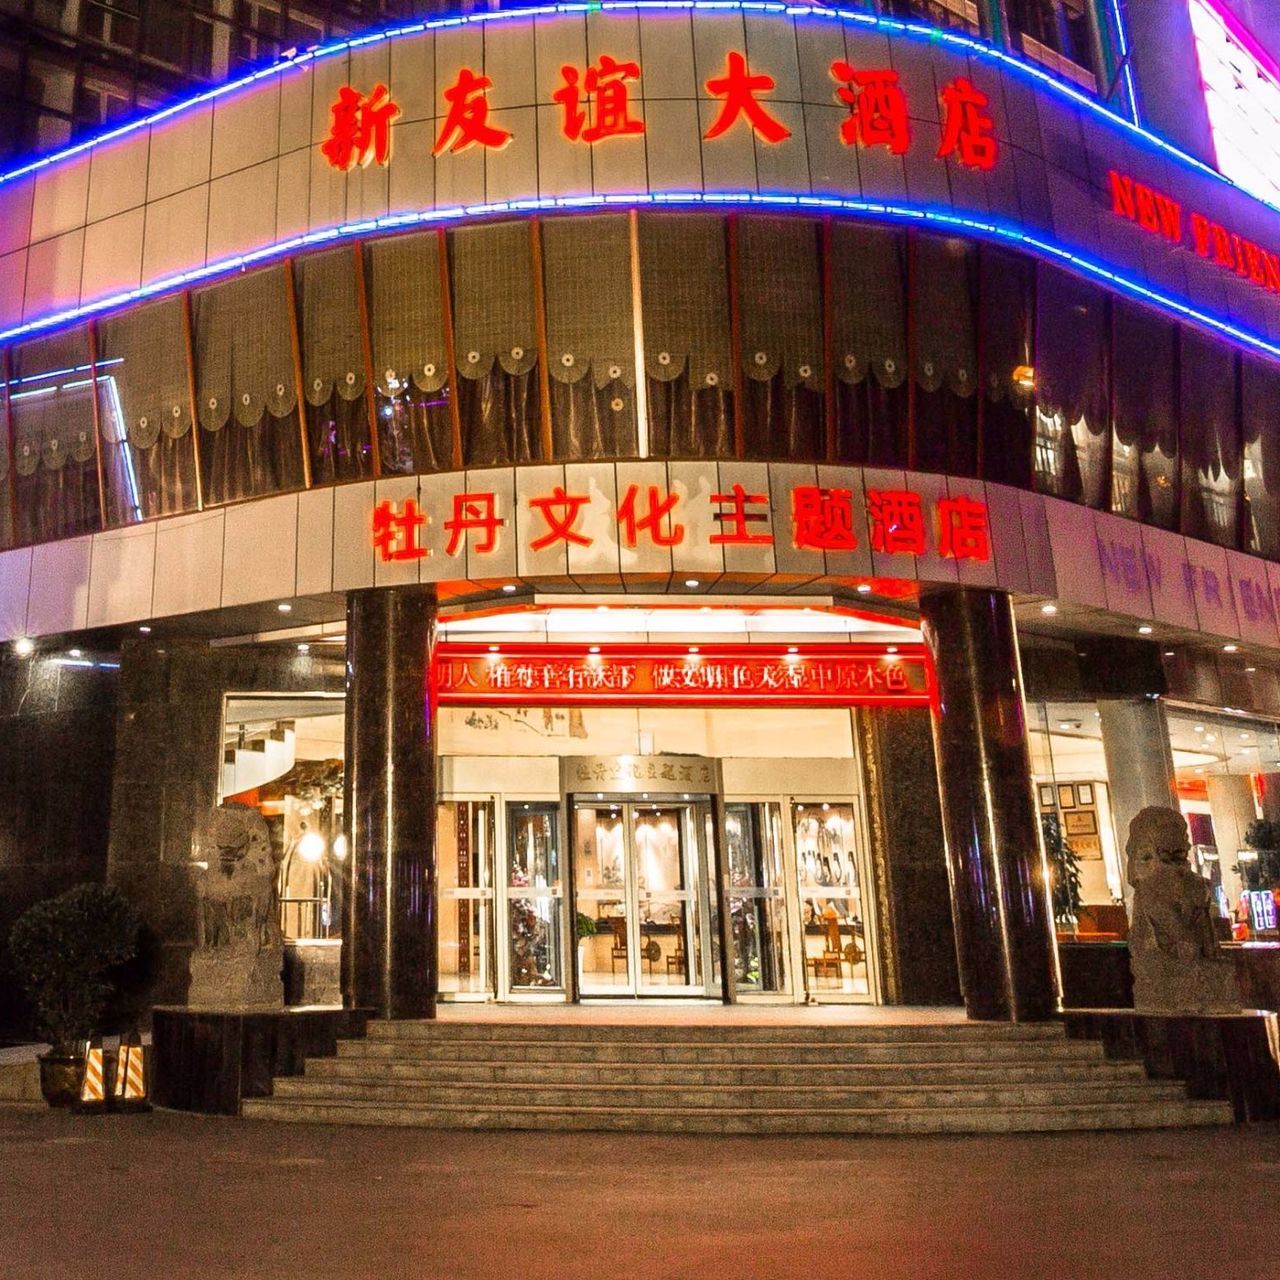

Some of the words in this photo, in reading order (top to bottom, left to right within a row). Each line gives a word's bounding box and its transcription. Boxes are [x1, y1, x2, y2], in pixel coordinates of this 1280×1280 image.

[322, 51, 999, 171] 新友谊大酒店
[1109, 170, 1181, 242] NEW
[372, 484, 990, 562] 牡丹文化主题酒店
